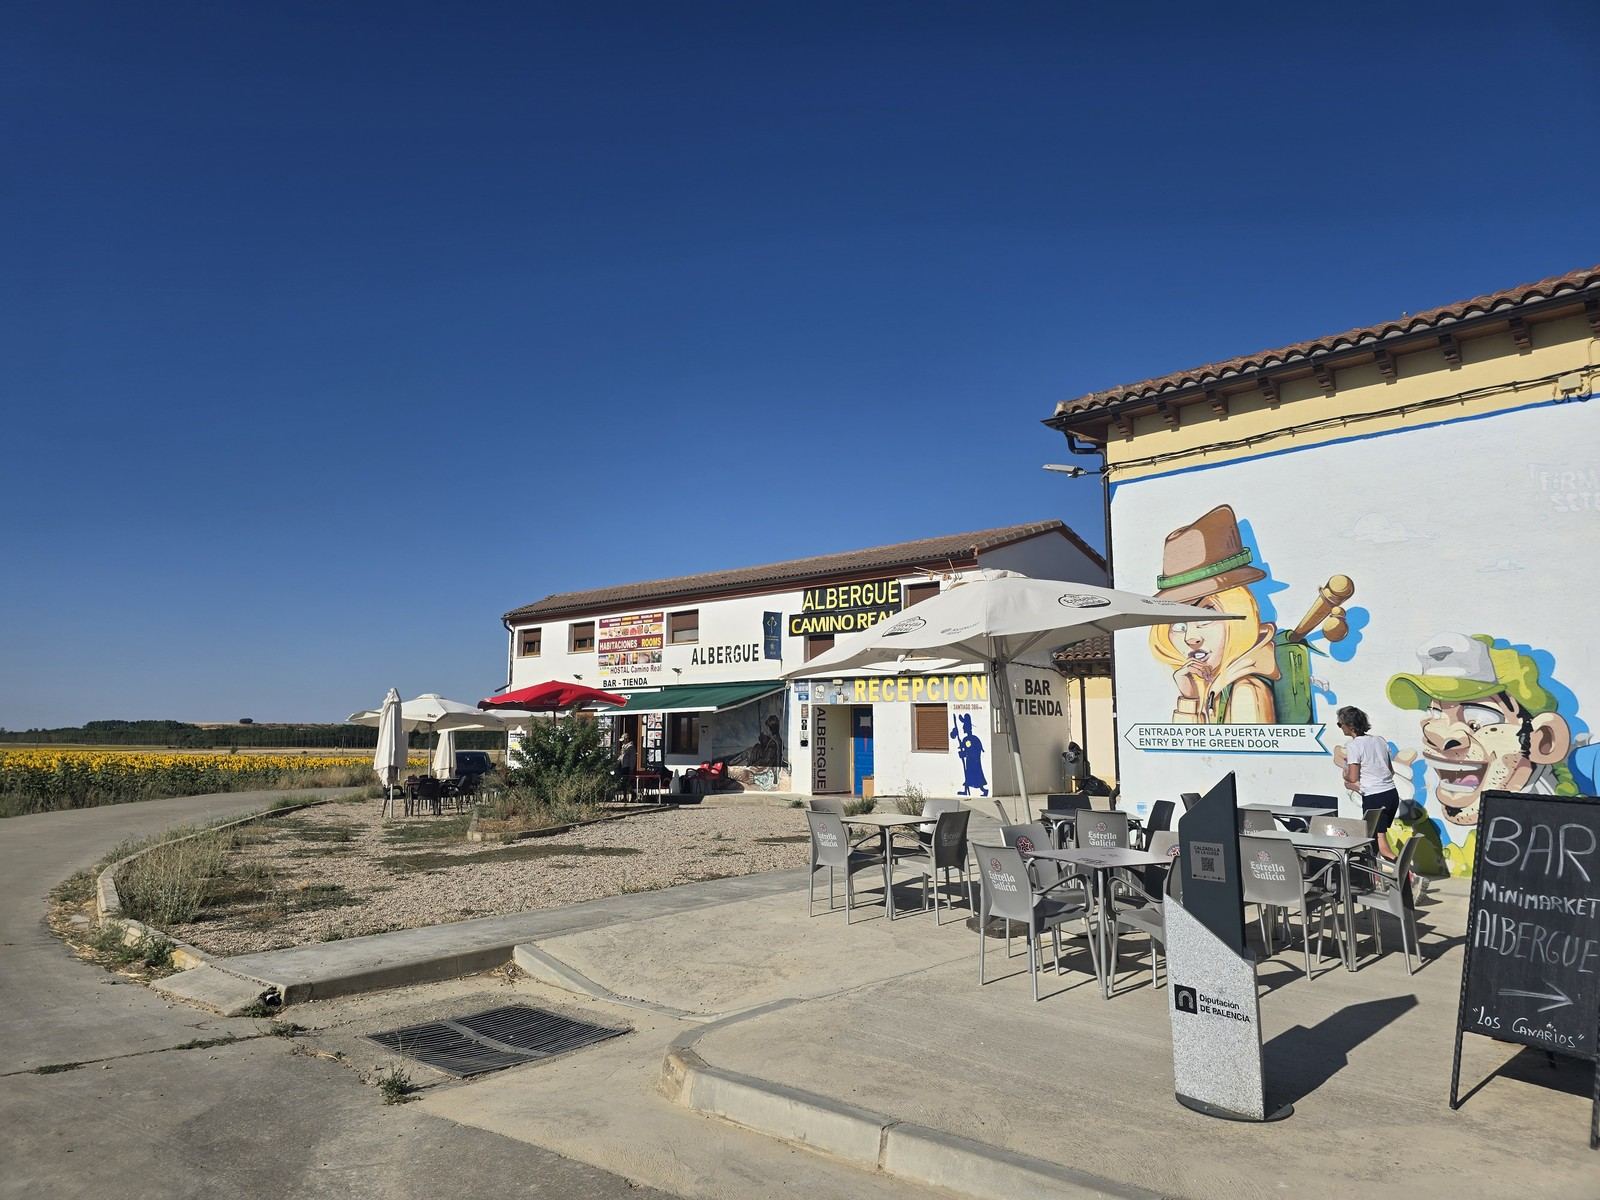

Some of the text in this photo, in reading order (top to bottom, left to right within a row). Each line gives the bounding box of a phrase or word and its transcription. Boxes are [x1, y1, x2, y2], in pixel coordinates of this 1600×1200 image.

[802, 580, 900, 611] ALBERGUE
[791, 614, 854, 634] CAMINO
[599, 637, 662, 651] HABITACIONES ROOMS
[692, 643, 759, 665] ALBERGUE
[610, 666, 630, 674] HOSTAL
[631, 665, 650, 673] Camino
[650, 664, 662, 672] Real
[603, 679, 616, 688] BAR
[622, 677, 648, 686] TIENDA
[854, 675, 988, 702] RECEPCION
[1024, 679, 1051, 696] BAR
[1016, 698, 1063, 717] TIENDA
[1138, 727, 1306, 738] ENTRADA POR LA PUERTA VERDE
[816, 707, 827, 789] ALBERGUE
[1139, 738, 1279, 748] ENTRY BY THE GREEN DOOR
[1088, 831, 1117, 840] Estrella
[1088, 838, 1117, 848] Galicia
[1484, 816, 1597, 883] BAR
[1250, 861, 1286, 872] Estrella
[988, 870, 1016, 883] Estrella
[1253, 870, 1286, 881] Galicia
[992, 879, 1018, 893] Galicia
[1474, 908, 1599, 974] ALBERGUE
[1199, 993, 1240, 1010] Diputación
[1199, 1004, 1251, 1023] DE PALENCIA
